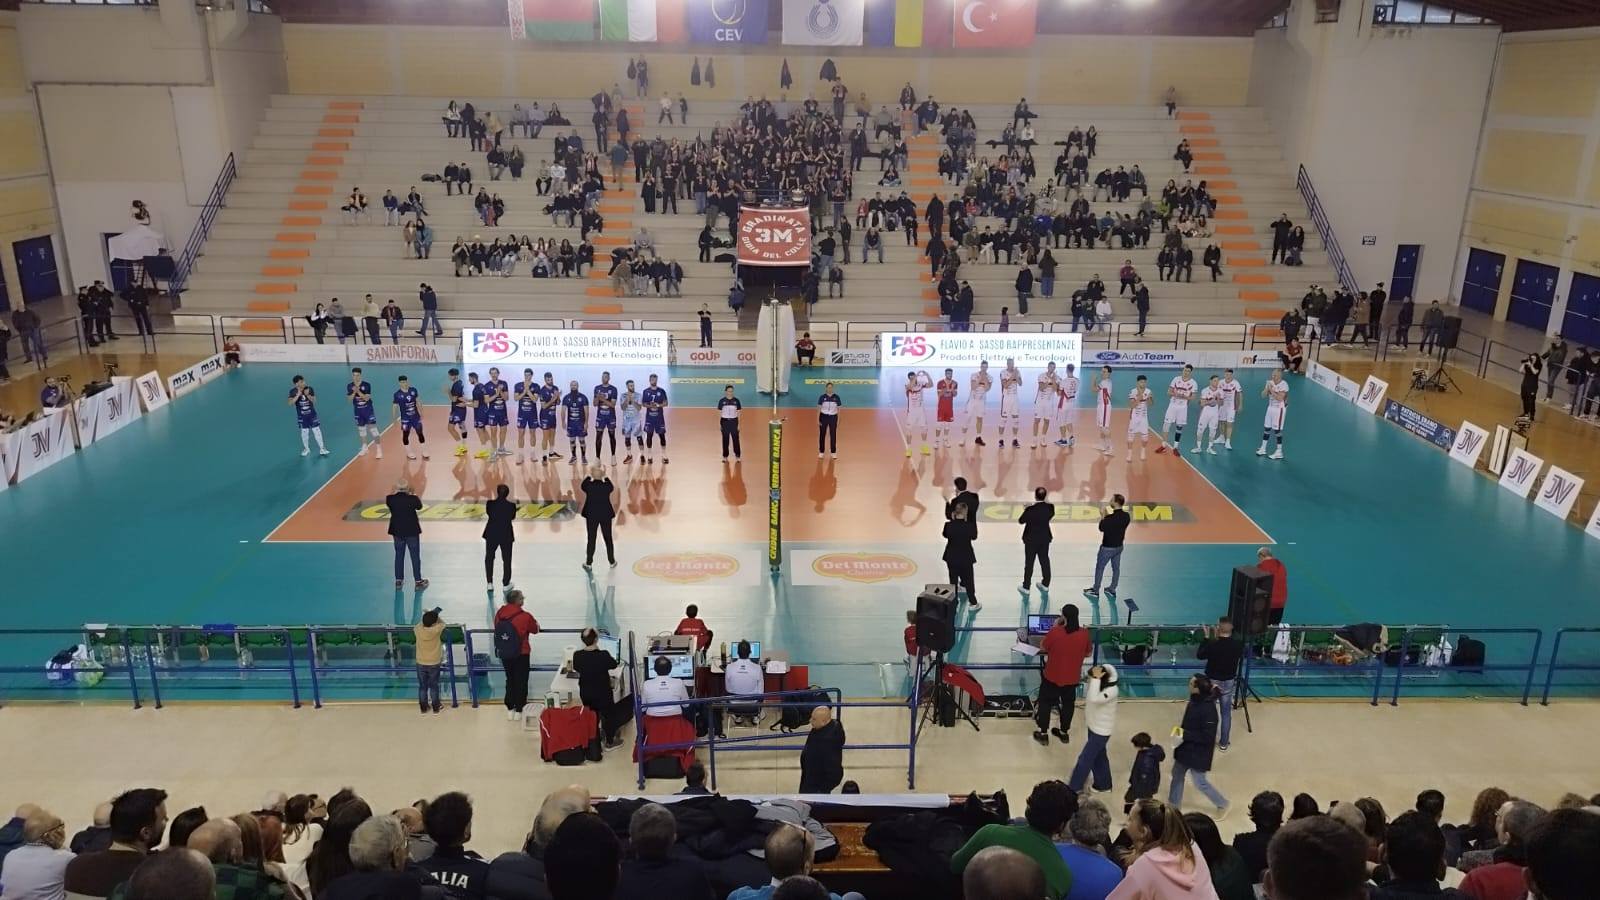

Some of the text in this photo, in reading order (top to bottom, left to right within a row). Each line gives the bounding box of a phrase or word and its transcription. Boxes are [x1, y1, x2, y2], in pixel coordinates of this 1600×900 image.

[715, 28, 743, 41] CEV
[742, 215, 806, 234] GRADINATA
[755, 228, 793, 243] 3M
[762, 251, 782, 259] DEL
[784, 236, 806, 257] COLLE
[473, 332, 510, 353] FAS
[524, 335, 551, 347] FLAVIO
[563, 336, 589, 347] SASSO
[591, 336, 661, 348] RAPPRESENTANZE
[891, 335, 927, 356] FAS
[940, 339, 968, 350] FLAVIO
[979, 339, 1005, 350] SASSO
[1006, 339, 1075, 351] RAPPRESENTANZE
[367, 344, 438, 362] SANINFORNA
[524, 350, 562, 358] Prodotti
[564, 350, 600, 359] Elettrici
[610, 351, 662, 361] Tecnologici
[690, 351, 720, 361] GOUP
[940, 353, 978, 361] Prodotti
[1024, 353, 1075, 363] Tecnologici
[1121, 352, 1174, 360] AutoTeam
[200, 357, 222, 372] max
[172, 369, 195, 386] max
[773, 428, 782, 458] BANCA
[772, 461, 780, 489] REDEM
[771, 500, 779, 526] BANC
[675, 560, 732, 570] Monte
[823, 561, 909, 570] Del Monte
